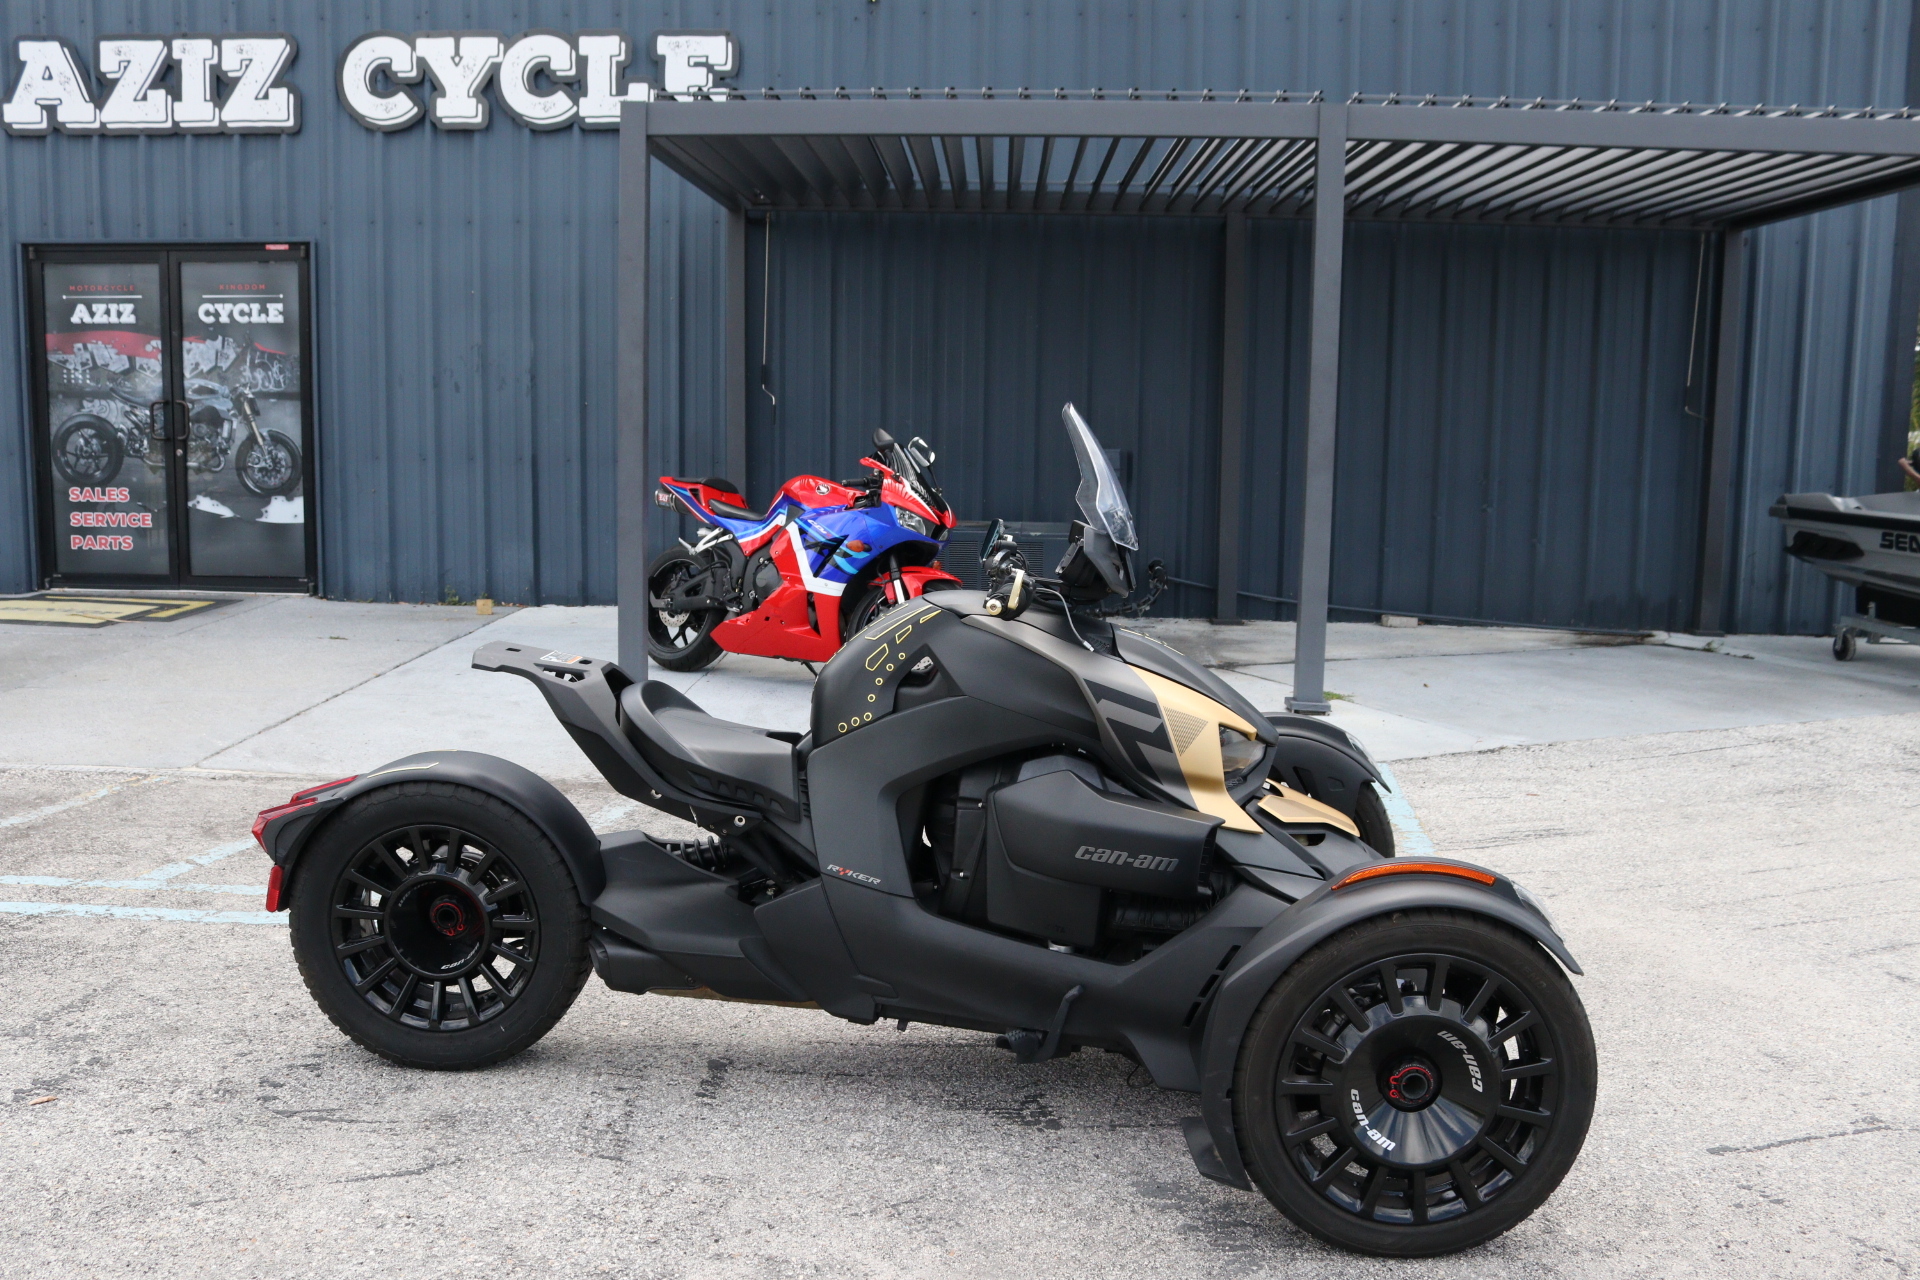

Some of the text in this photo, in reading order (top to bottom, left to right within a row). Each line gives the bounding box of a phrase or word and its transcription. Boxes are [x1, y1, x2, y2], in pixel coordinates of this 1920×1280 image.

[3, 34, 741, 128] AZIZ CYCLE
[69, 283, 266, 292] MOTORCYCLE KINGDOM
[70, 303, 284, 324] AZIZ CYCLE
[69, 487, 130, 502] SALES
[70, 512, 152, 527] SERVICE
[71, 535, 133, 550] PARTS
[1075, 845, 1179, 872] can-am
[827, 864, 881, 884] RYKER
[1437, 1030, 1484, 1093] can-am
[1350, 1088, 1397, 1151] can-am
